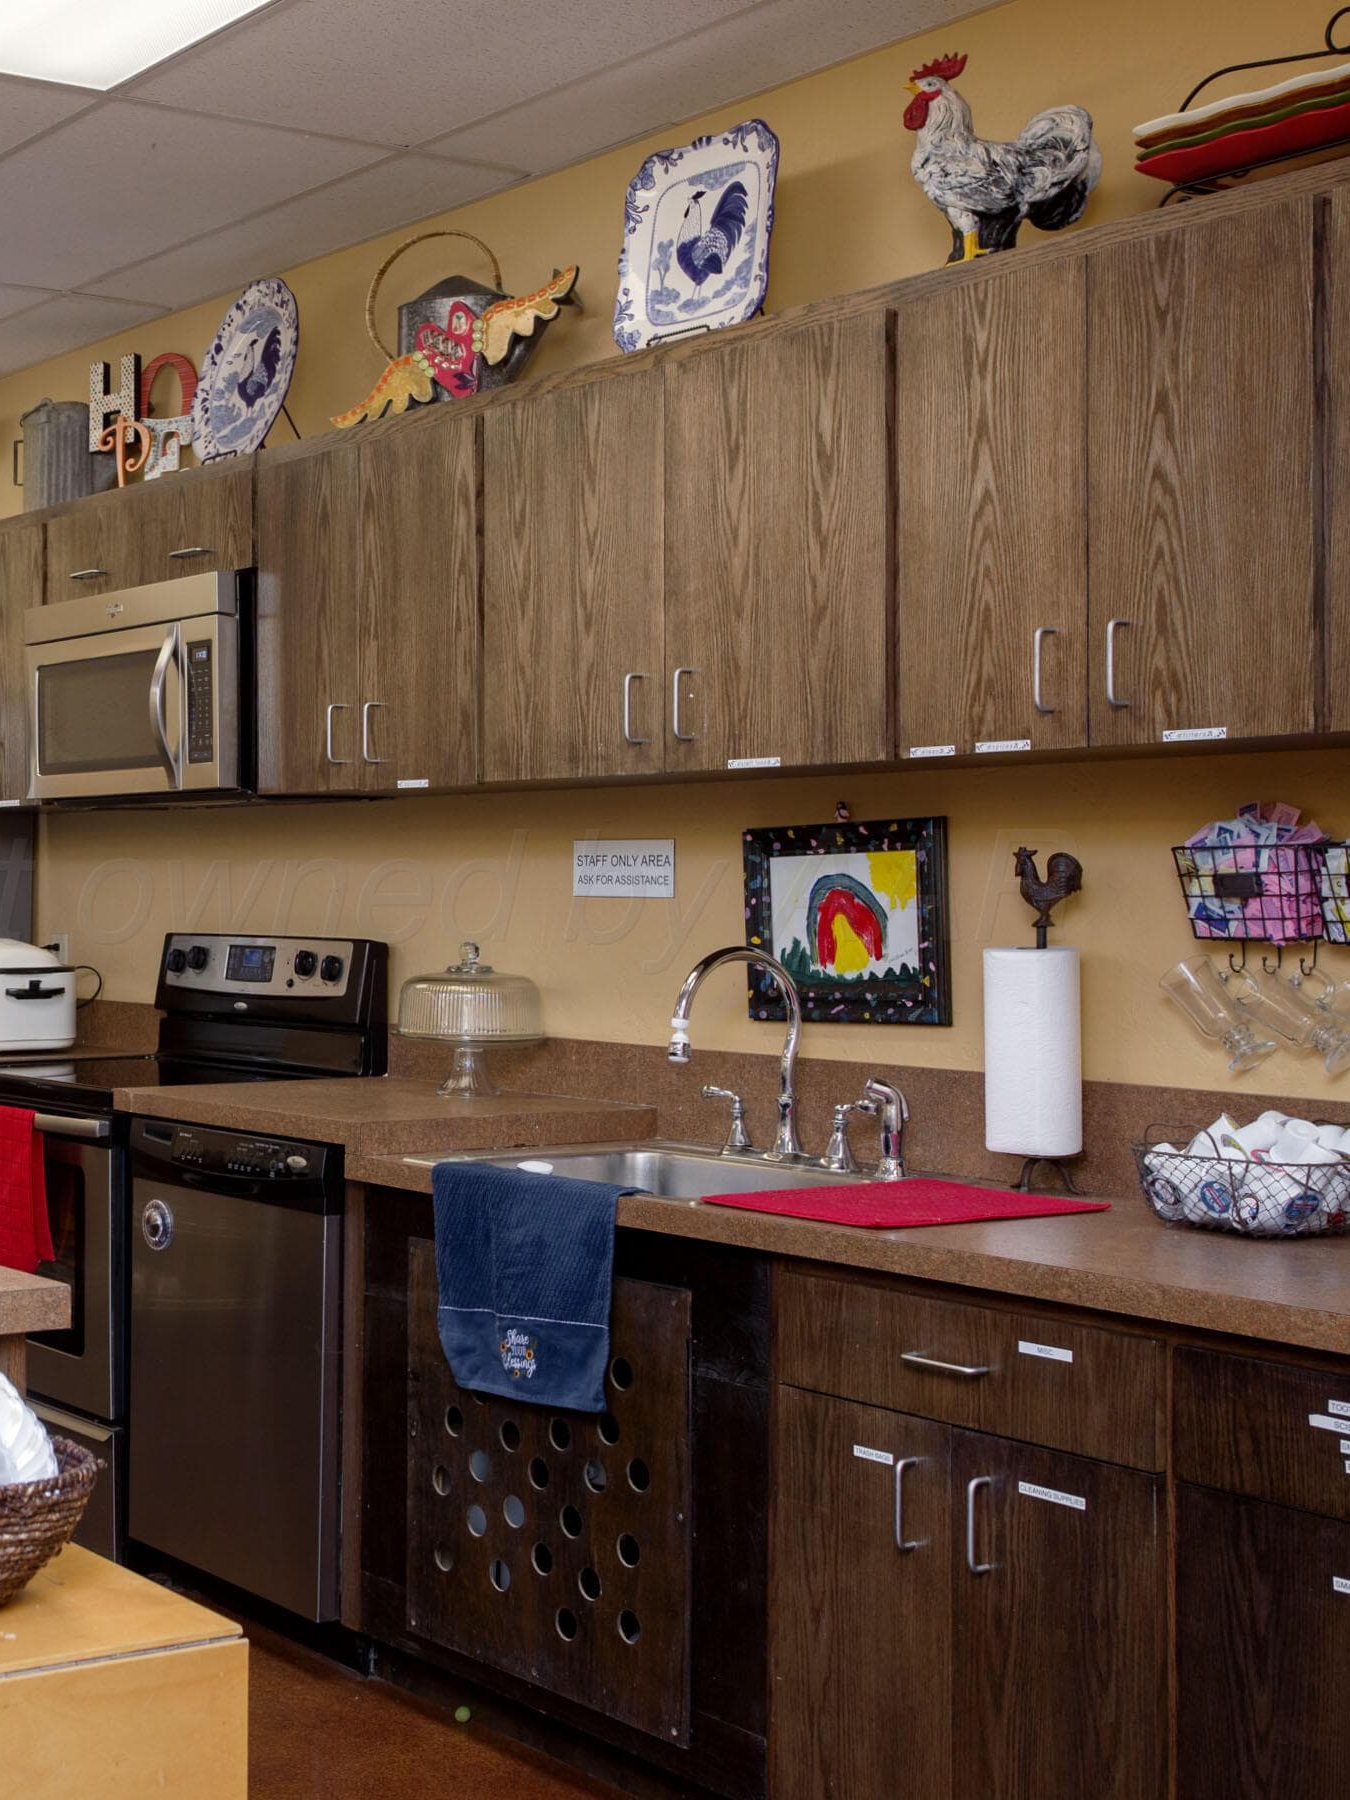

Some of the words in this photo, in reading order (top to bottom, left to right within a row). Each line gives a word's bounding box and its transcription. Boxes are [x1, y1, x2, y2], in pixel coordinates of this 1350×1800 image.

[577, 855, 608, 867] STAFF
[610, 855, 639, 868] ONLY
[640, 855, 671, 867] AREA
[577, 875, 594, 885] ASK
[595, 875, 613, 885] FOR
[614, 875, 670, 886] ASSISTANCE
[1020, 1483, 1052, 1499] CLEANING
